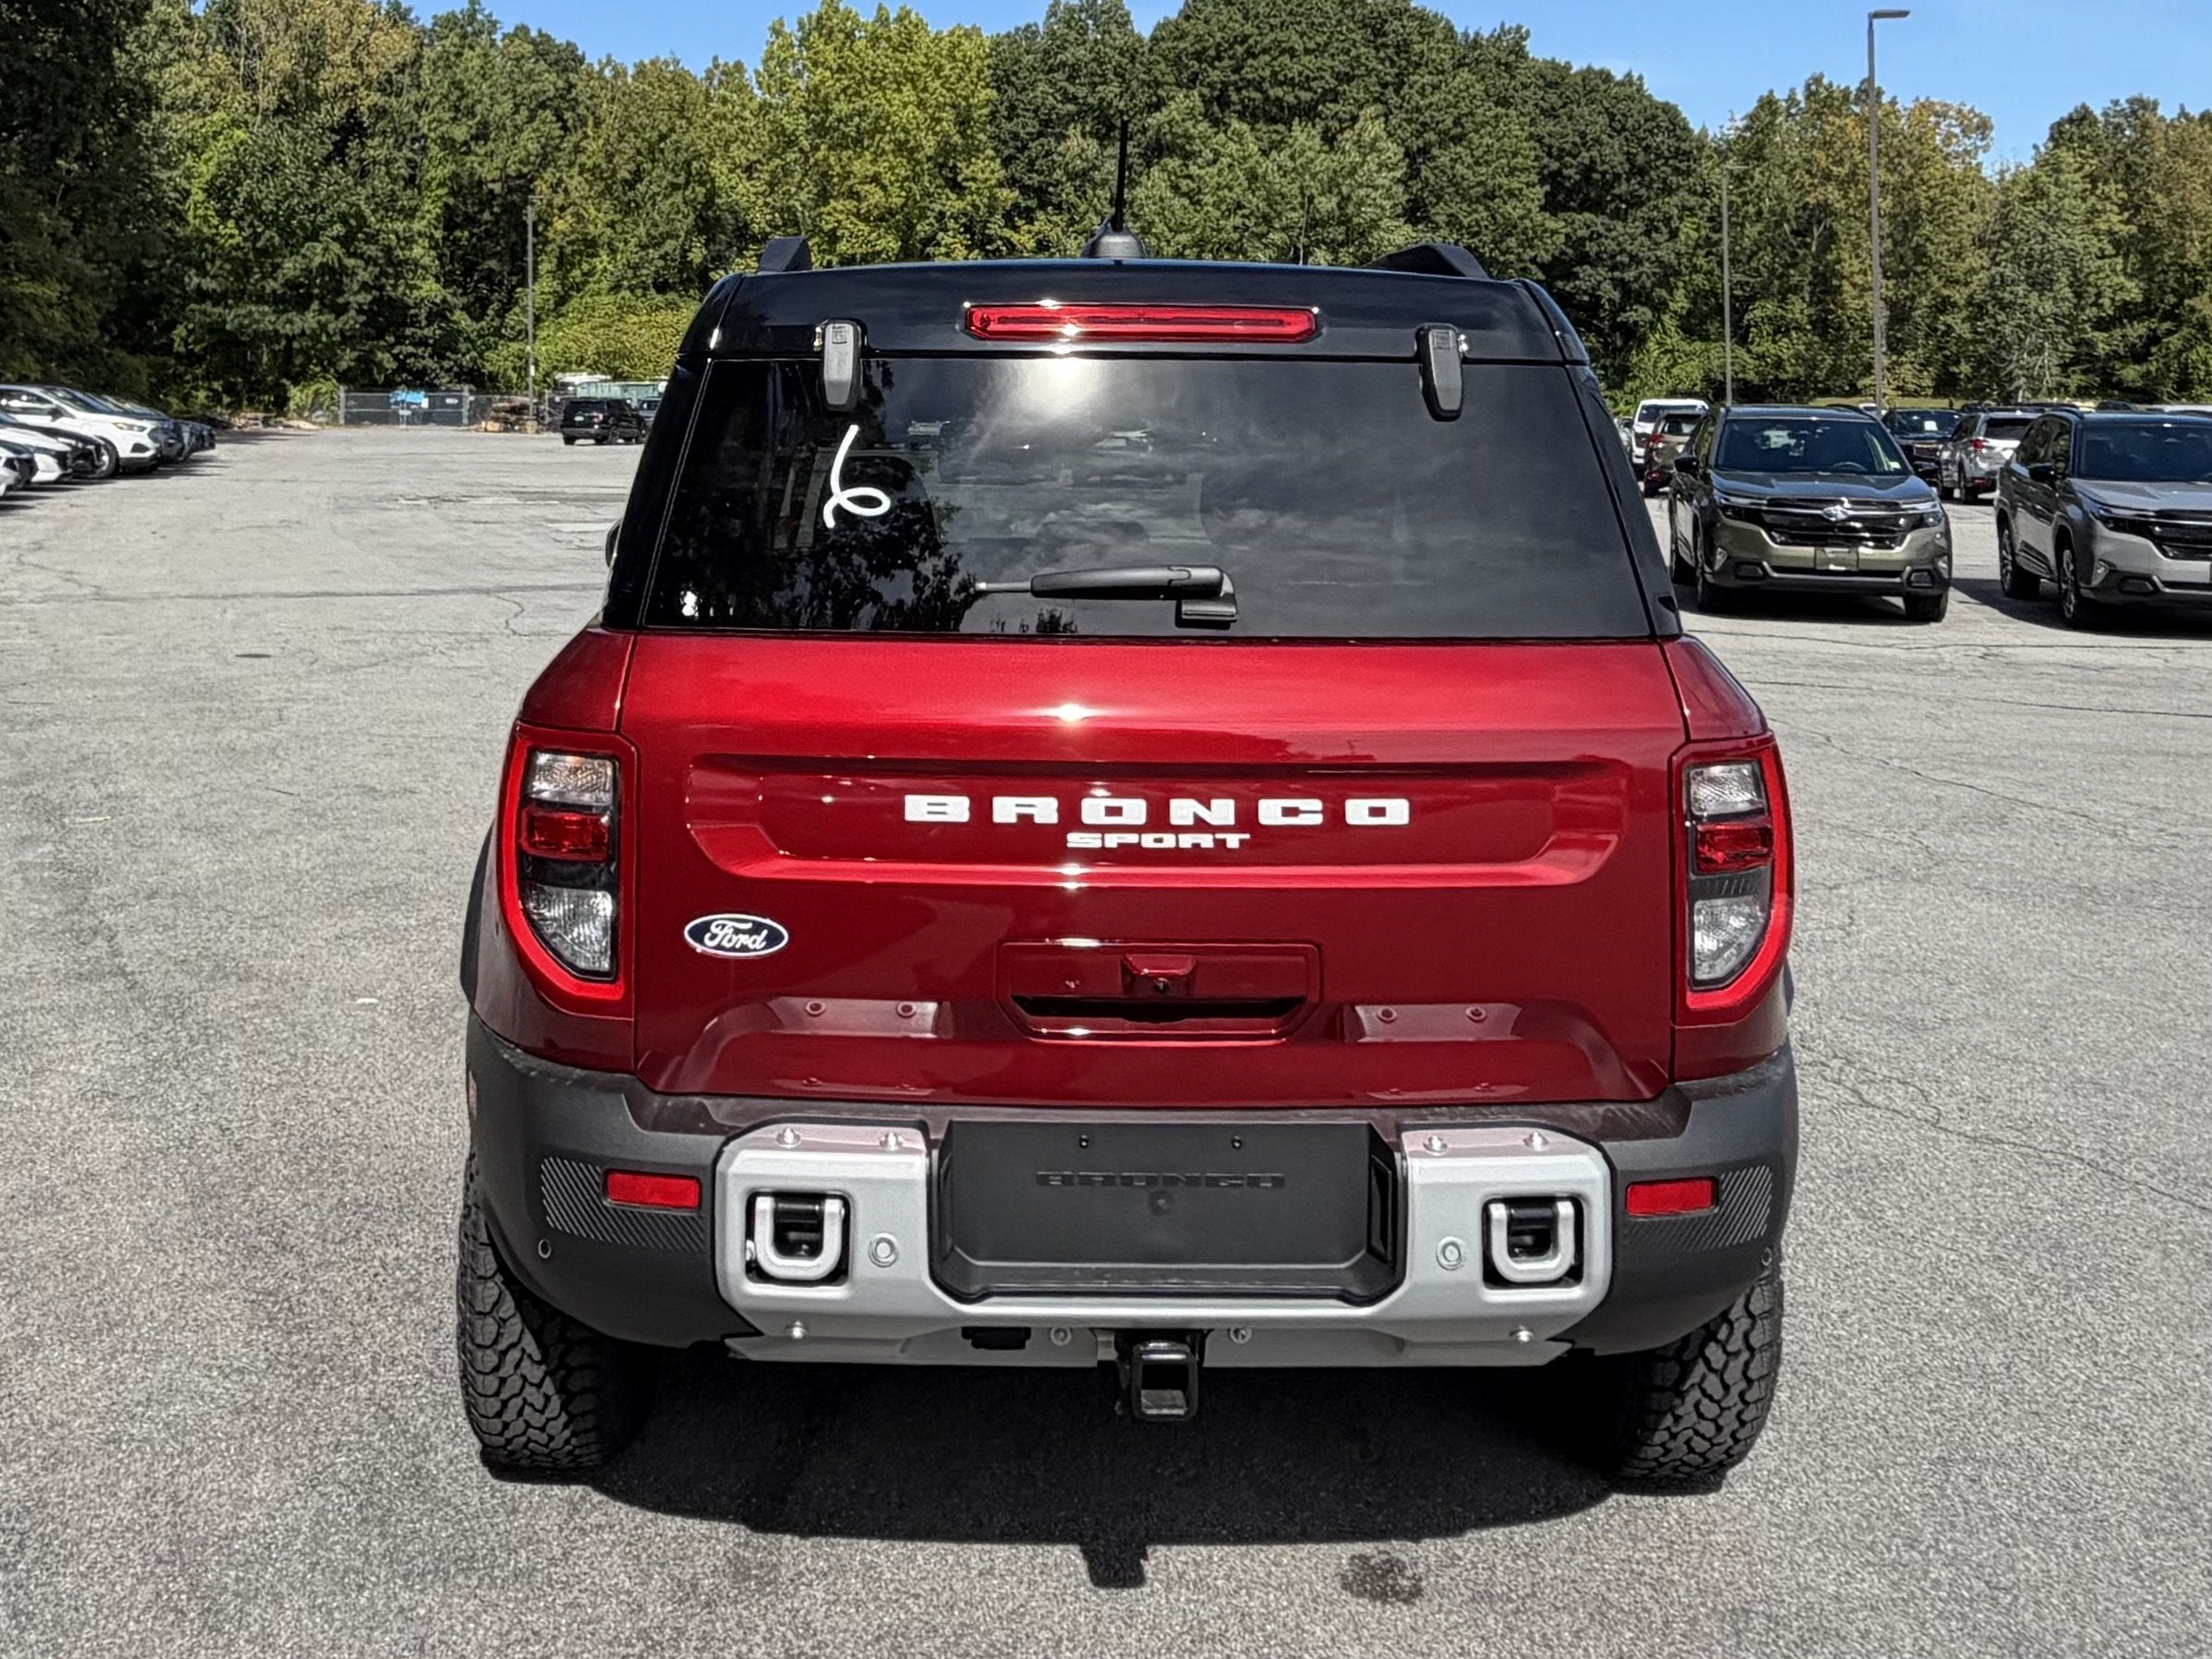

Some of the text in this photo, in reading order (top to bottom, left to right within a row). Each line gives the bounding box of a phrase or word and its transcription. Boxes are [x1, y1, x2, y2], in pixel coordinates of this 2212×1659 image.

[904, 794, 1410, 825] BRONCO
[1066, 832, 1251, 848] SPORT
[703, 920, 768, 950] Ford
[1035, 1172, 1286, 1187] BRONCO
